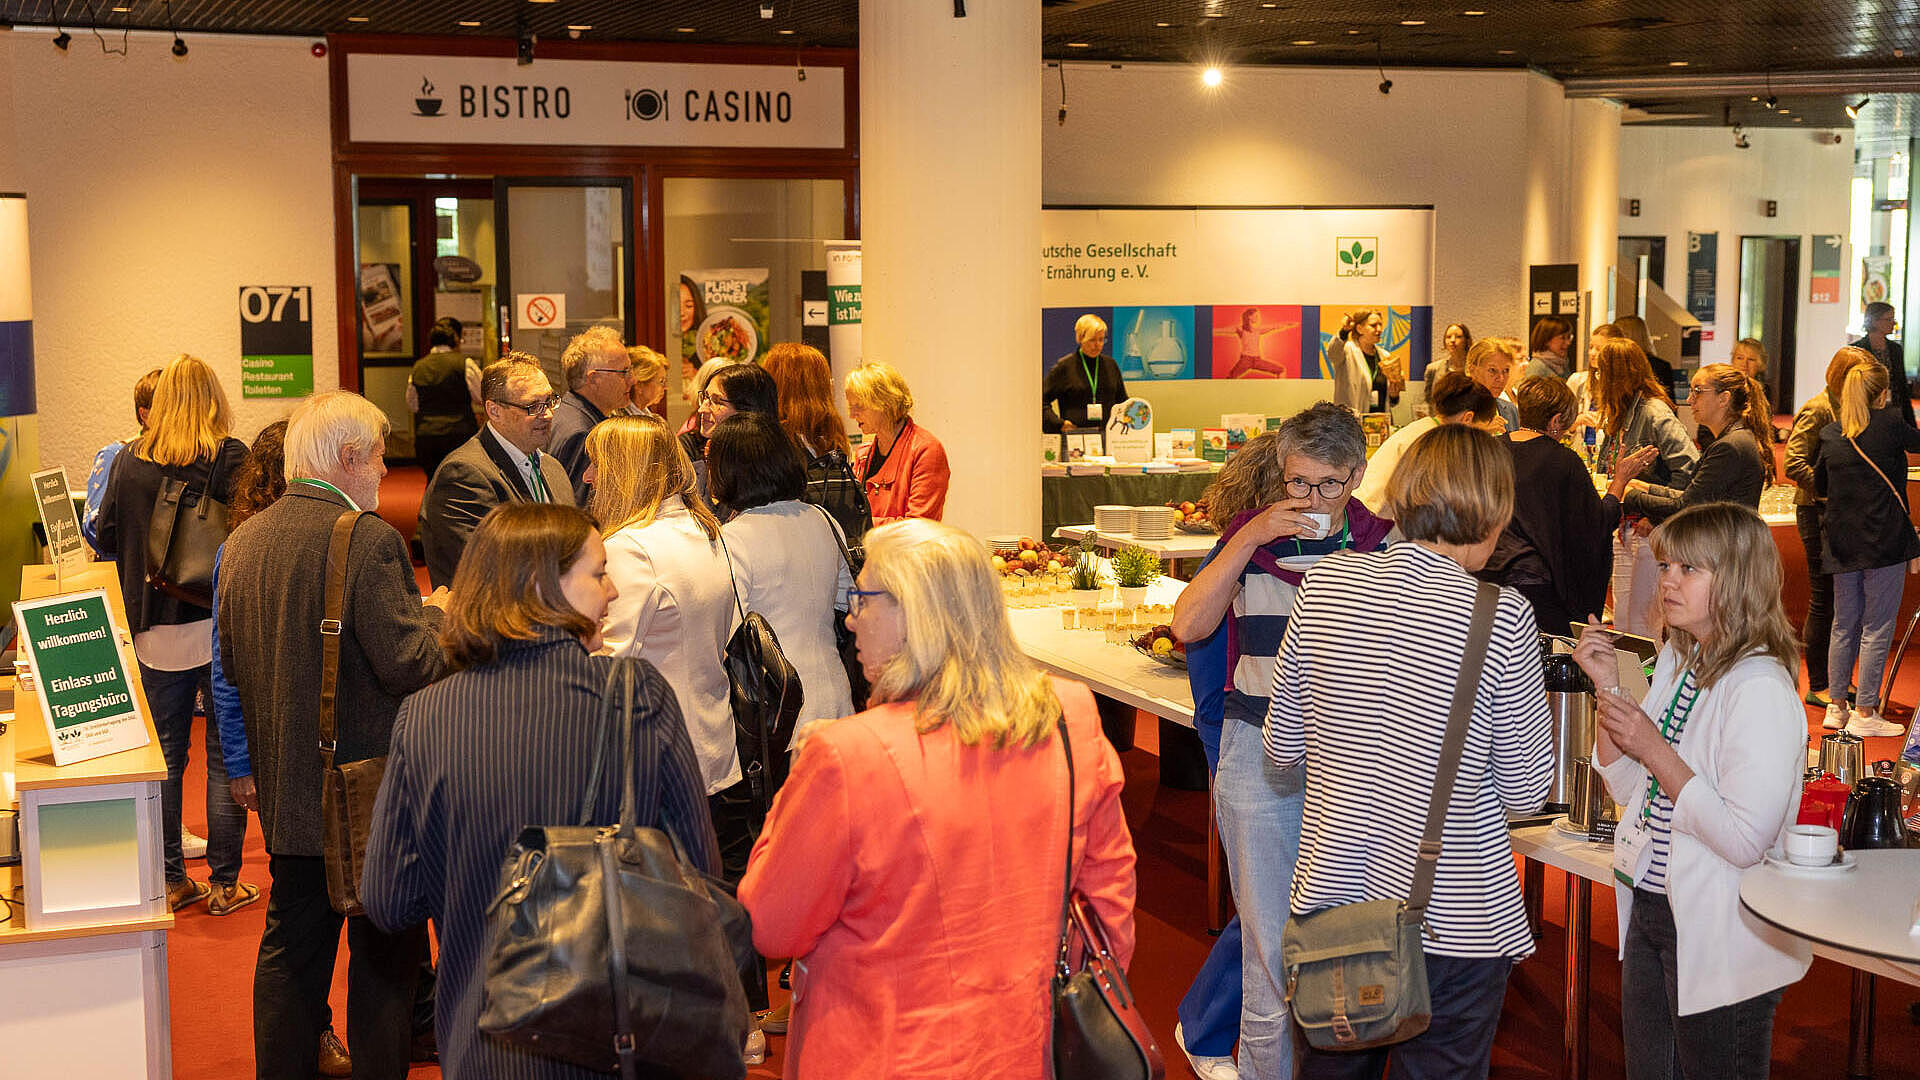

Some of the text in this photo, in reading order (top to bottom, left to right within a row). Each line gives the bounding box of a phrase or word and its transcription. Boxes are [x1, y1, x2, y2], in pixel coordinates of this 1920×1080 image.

[459, 85, 571, 119] BISTRO
[684, 89, 793, 123] CASINO
[1086, 242, 1177, 258] Gesellschaft
[1047, 263, 1116, 282] Ernährung
[1136, 264, 1149, 279] V.
[704, 279, 749, 294] PLANET
[240, 286, 309, 323] 071
[704, 293, 748, 305] POWER
[835, 290, 853, 303] Wie
[1562, 297, 1576, 307] WC
[836, 307, 848, 320] ist
[241, 359, 274, 368] Casino
[243, 371, 294, 381] Restaurant
[244, 385, 283, 395] Toiletten
[44, 607, 89, 627] Herzlich
[36, 626, 107, 651] willkommen!
[50, 666, 118, 694] Einlass und
[51, 692, 129, 719] Tagungsbüro
